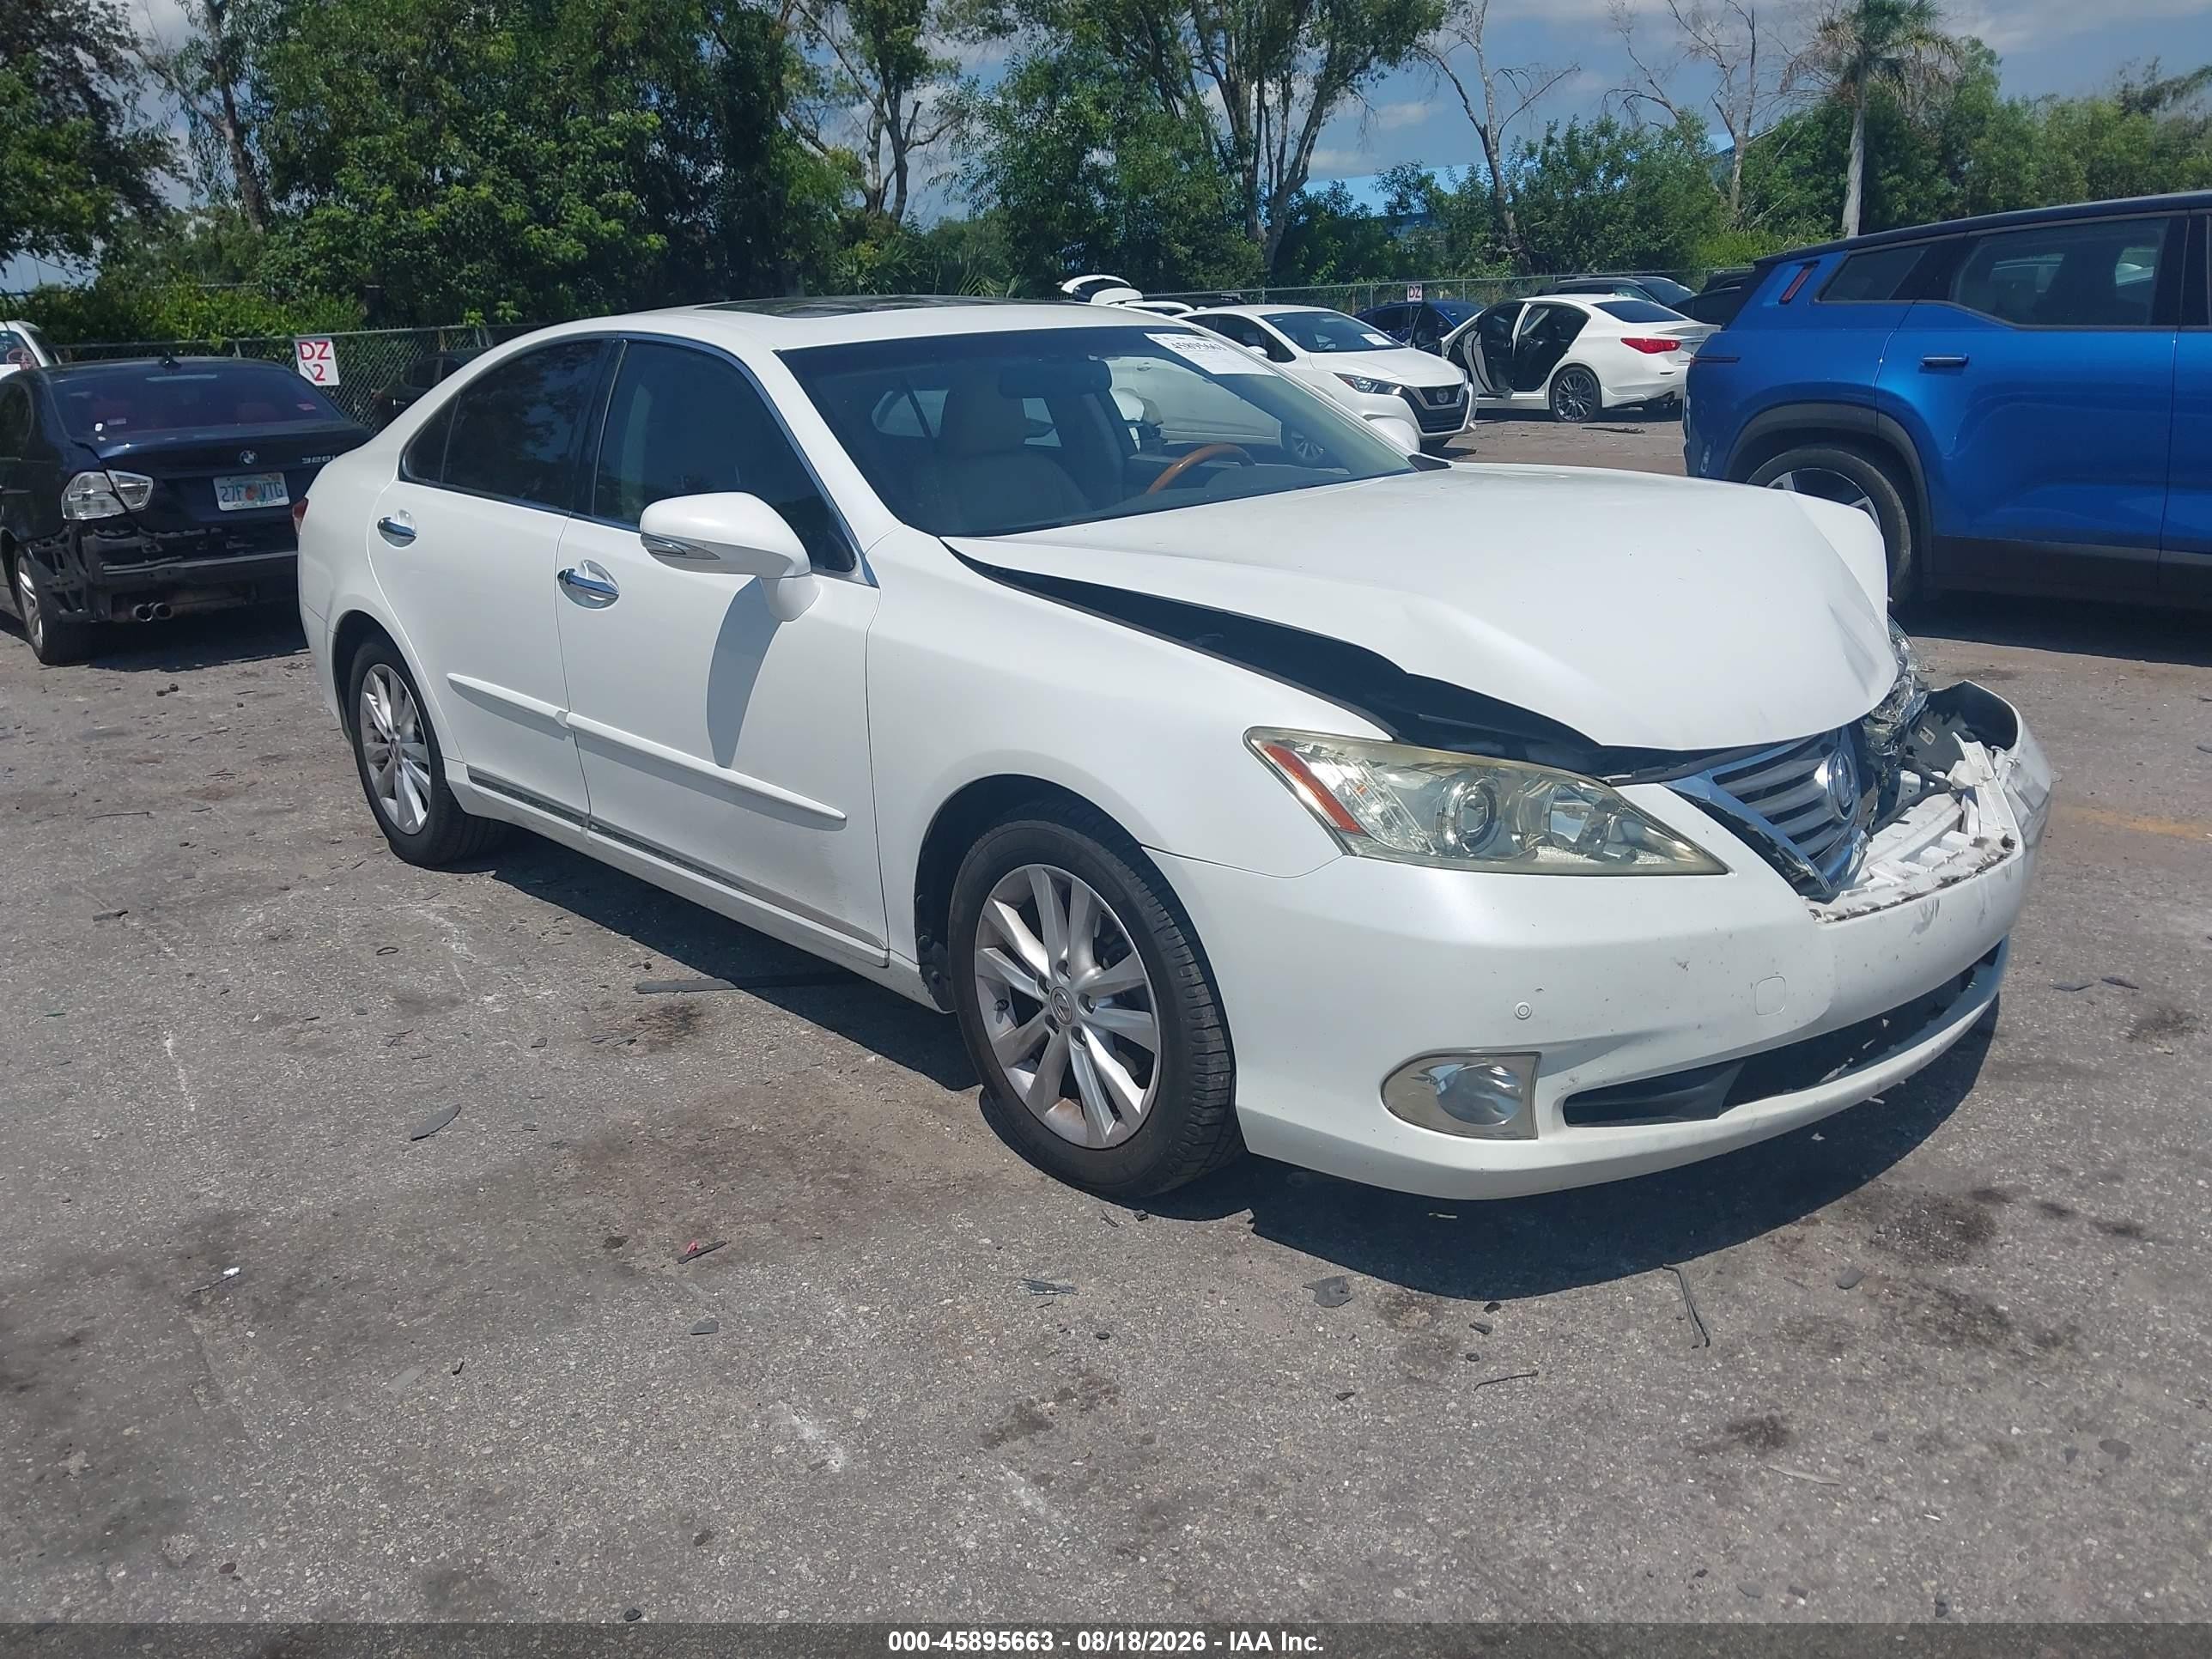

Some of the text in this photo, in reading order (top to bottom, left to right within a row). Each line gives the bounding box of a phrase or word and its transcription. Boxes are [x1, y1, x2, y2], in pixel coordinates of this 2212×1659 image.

[1409, 285, 1421, 298] DZ
[298, 342, 331, 360] DZ
[313, 363, 325, 381] 2
